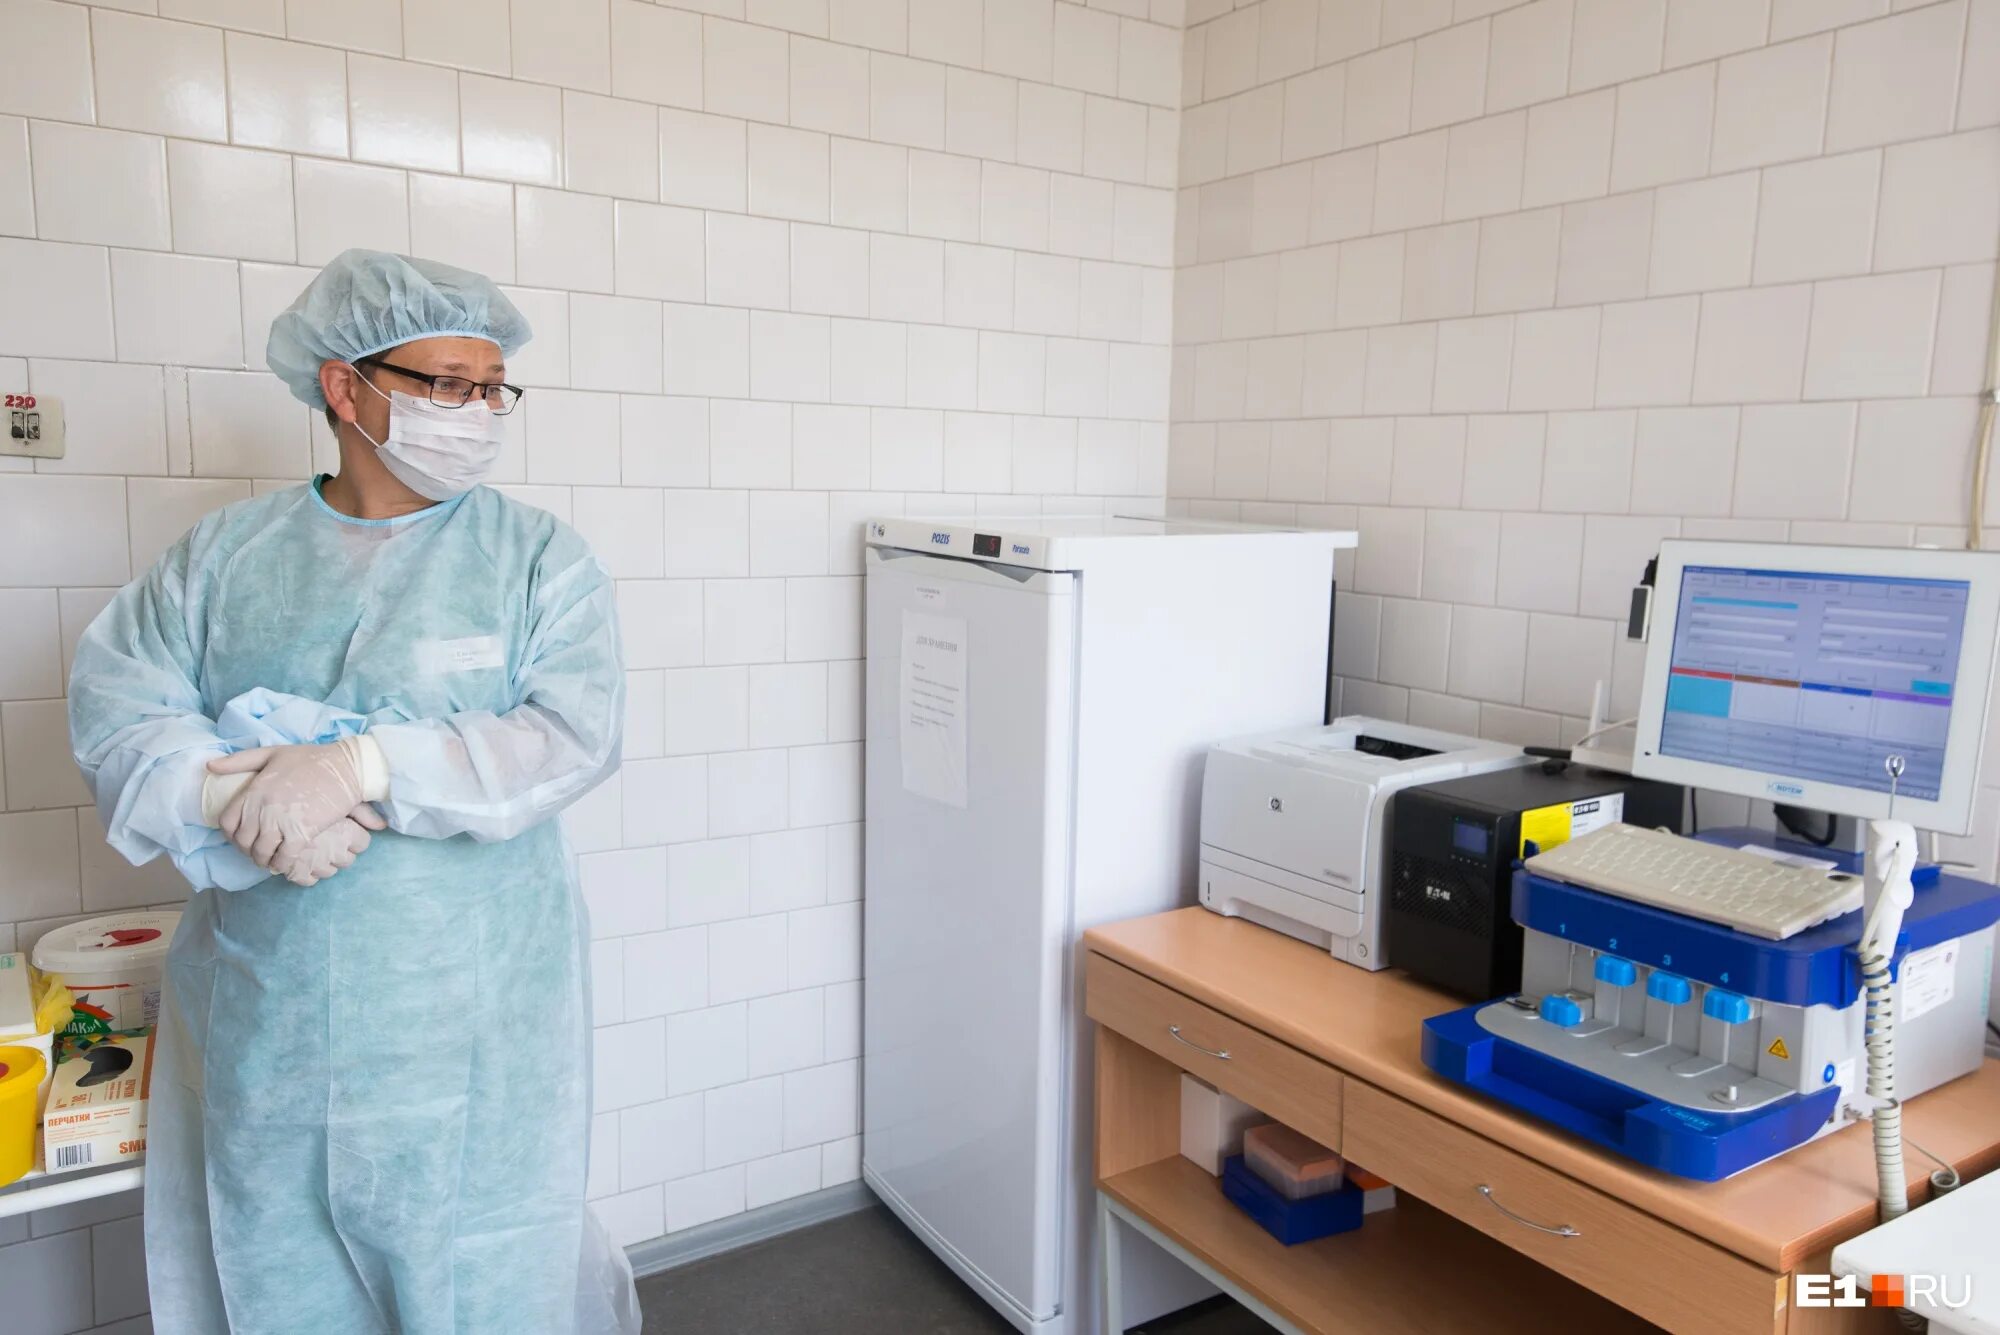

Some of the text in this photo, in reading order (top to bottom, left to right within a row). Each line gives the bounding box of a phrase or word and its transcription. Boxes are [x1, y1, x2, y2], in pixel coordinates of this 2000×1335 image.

[5, 395, 36, 409] 220
[931, 532, 951, 545] POZIS
[1559, 924, 1566, 934] 1
[1609, 938, 1618, 949] 2
[1662, 954, 1672, 966] 3
[1720, 972, 1729, 984] 4
